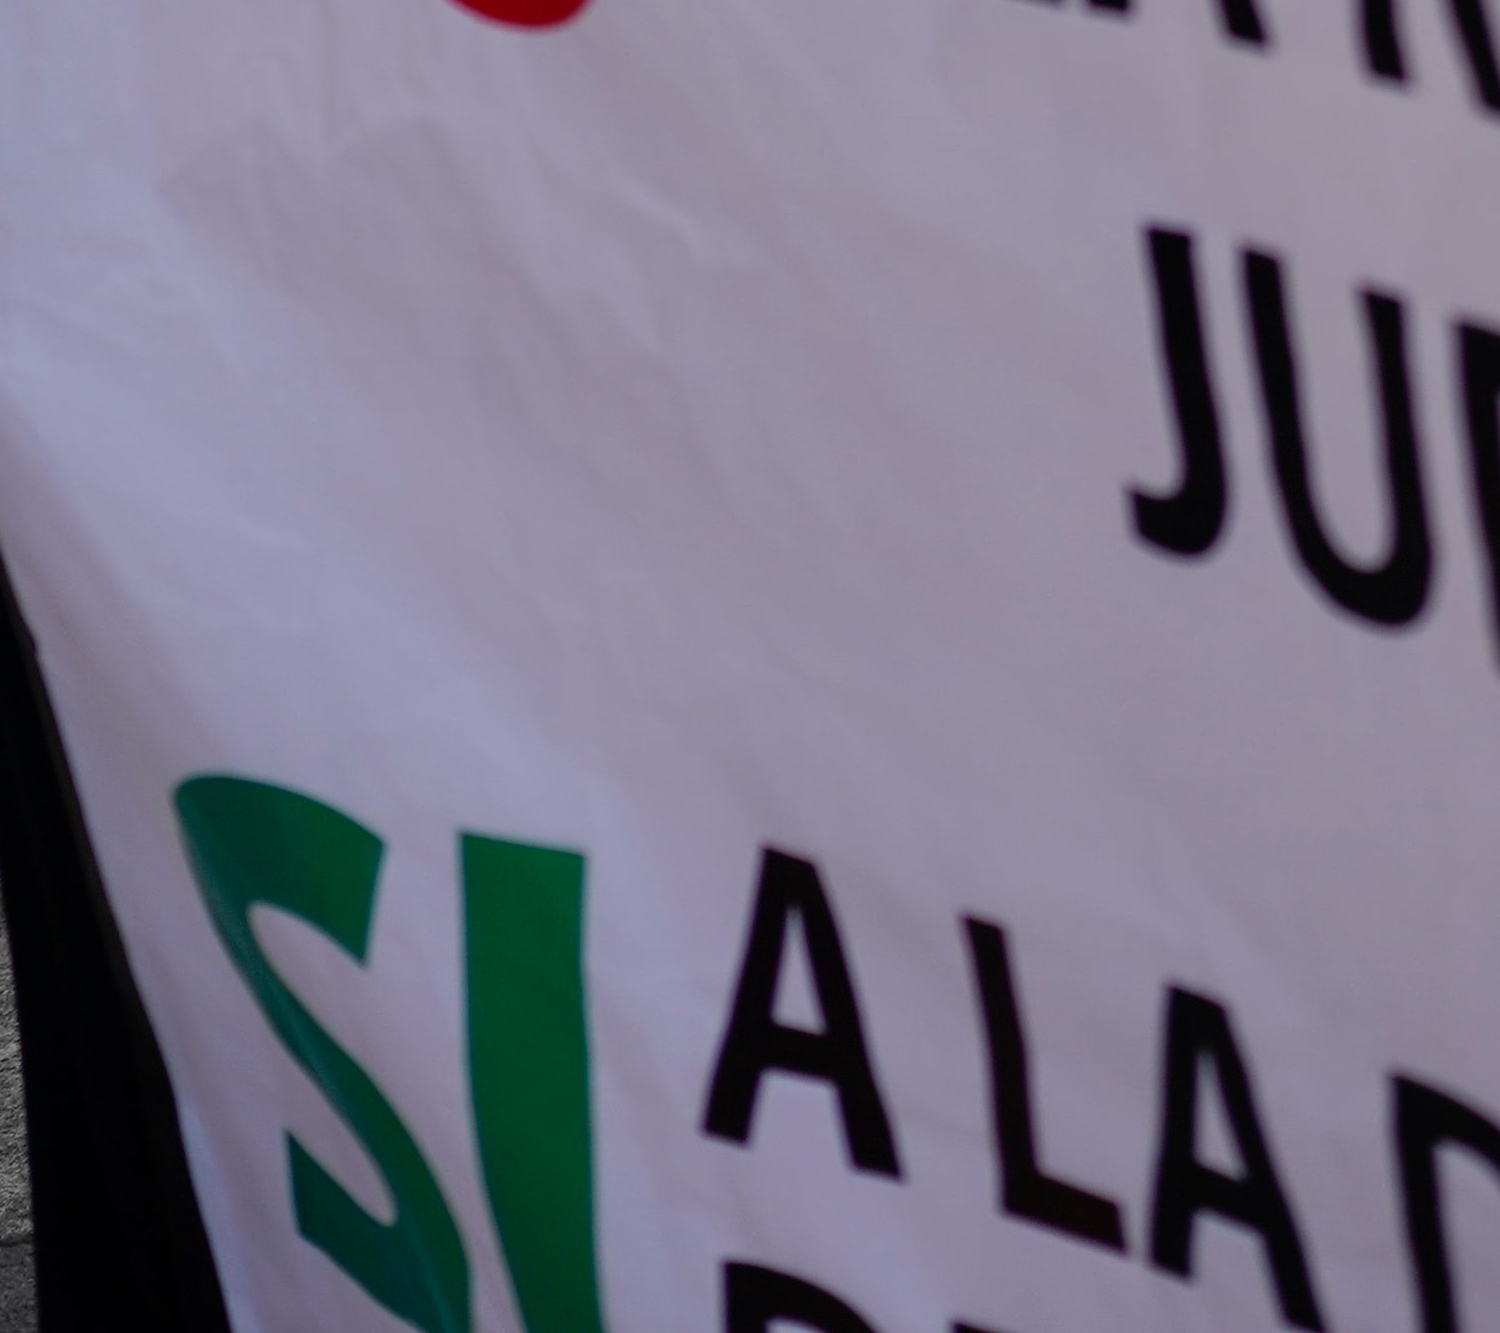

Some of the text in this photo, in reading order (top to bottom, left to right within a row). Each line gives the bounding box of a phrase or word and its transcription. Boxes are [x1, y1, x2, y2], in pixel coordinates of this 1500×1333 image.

[174, 774, 604, 1333] SI
[702, 845, 904, 1181] A
[960, 911, 1330, 1333] LA
